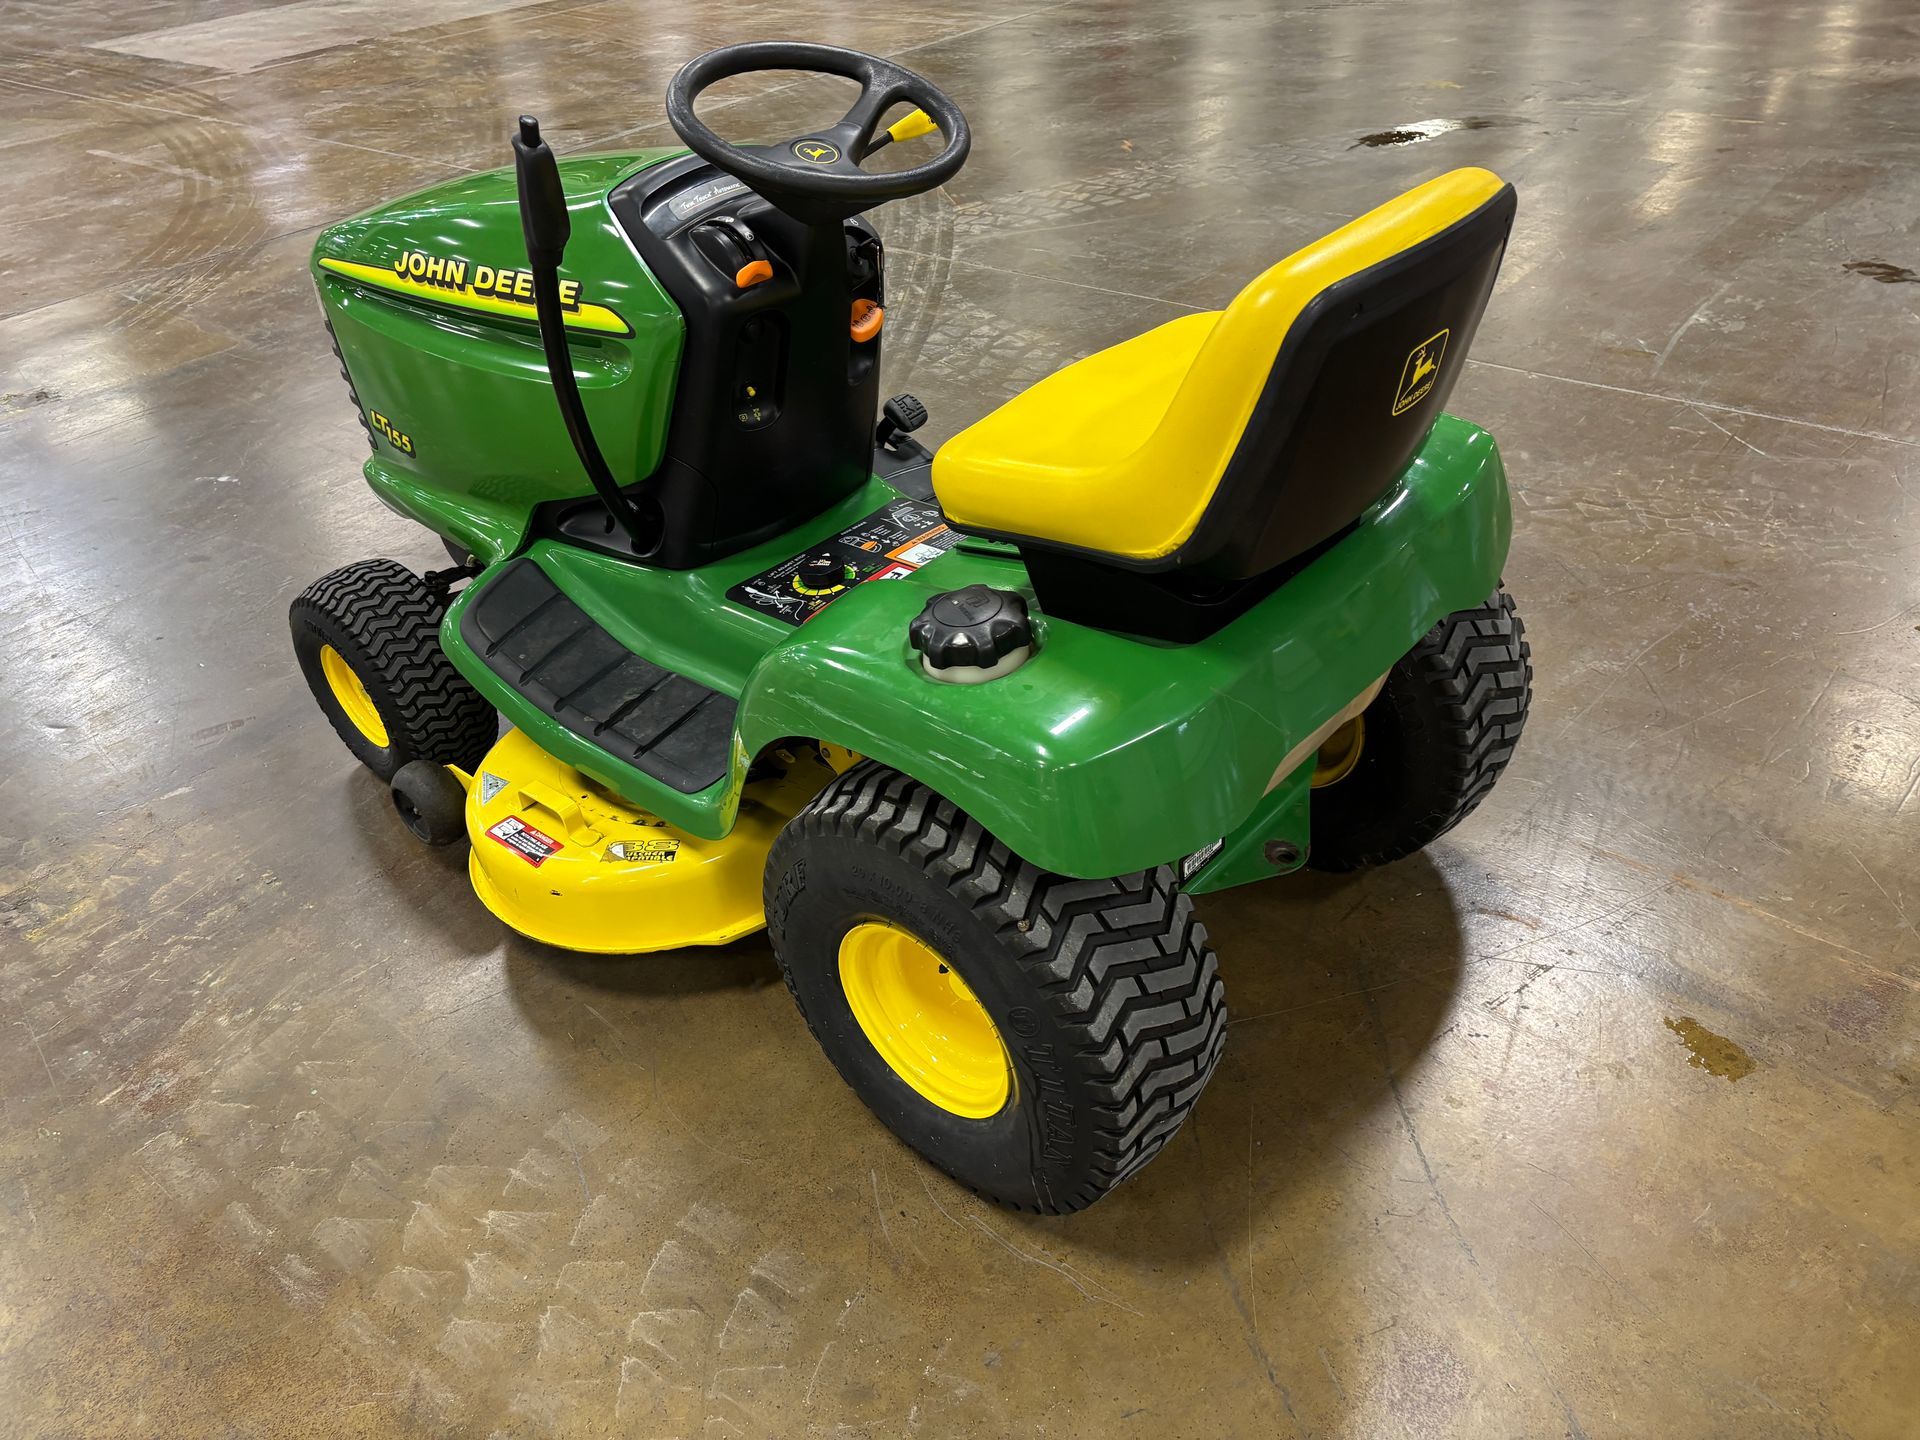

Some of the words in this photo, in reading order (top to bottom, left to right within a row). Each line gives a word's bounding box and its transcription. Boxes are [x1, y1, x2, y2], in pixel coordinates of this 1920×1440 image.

[394, 250, 467, 288] JOHN
[473, 265, 582, 308] DEEE
[370, 409, 412, 453] LT155
